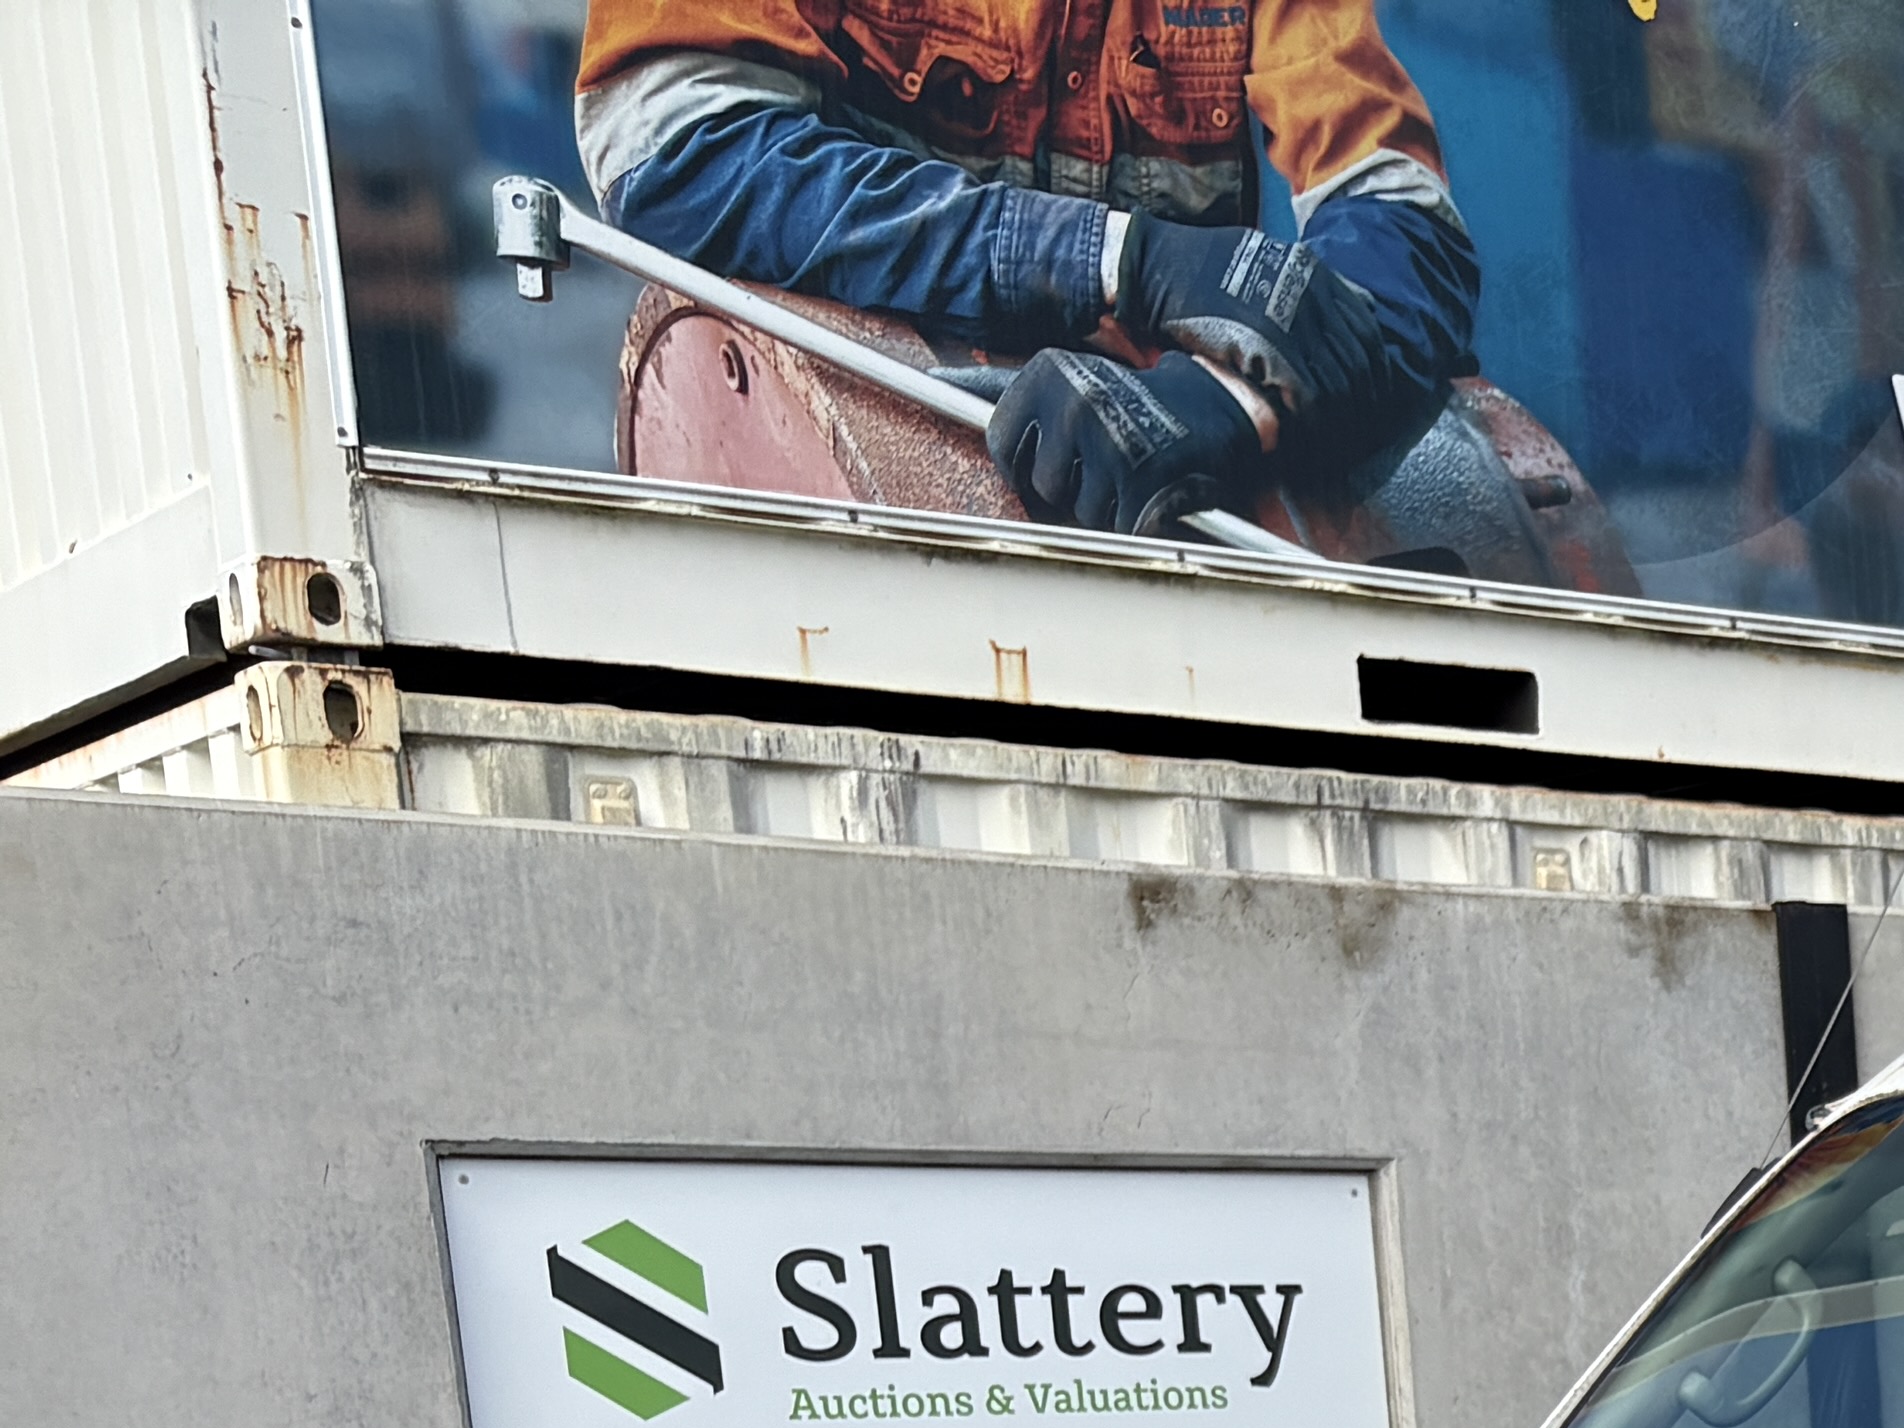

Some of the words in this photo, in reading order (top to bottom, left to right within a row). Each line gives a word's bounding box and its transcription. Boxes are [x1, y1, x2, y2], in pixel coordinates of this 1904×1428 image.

[775, 1244, 1303, 1387] Slattery
[789, 1383, 974, 1421] Auctions
[986, 1384, 1015, 1416] &
[1024, 1378, 1229, 1414] Valuations
